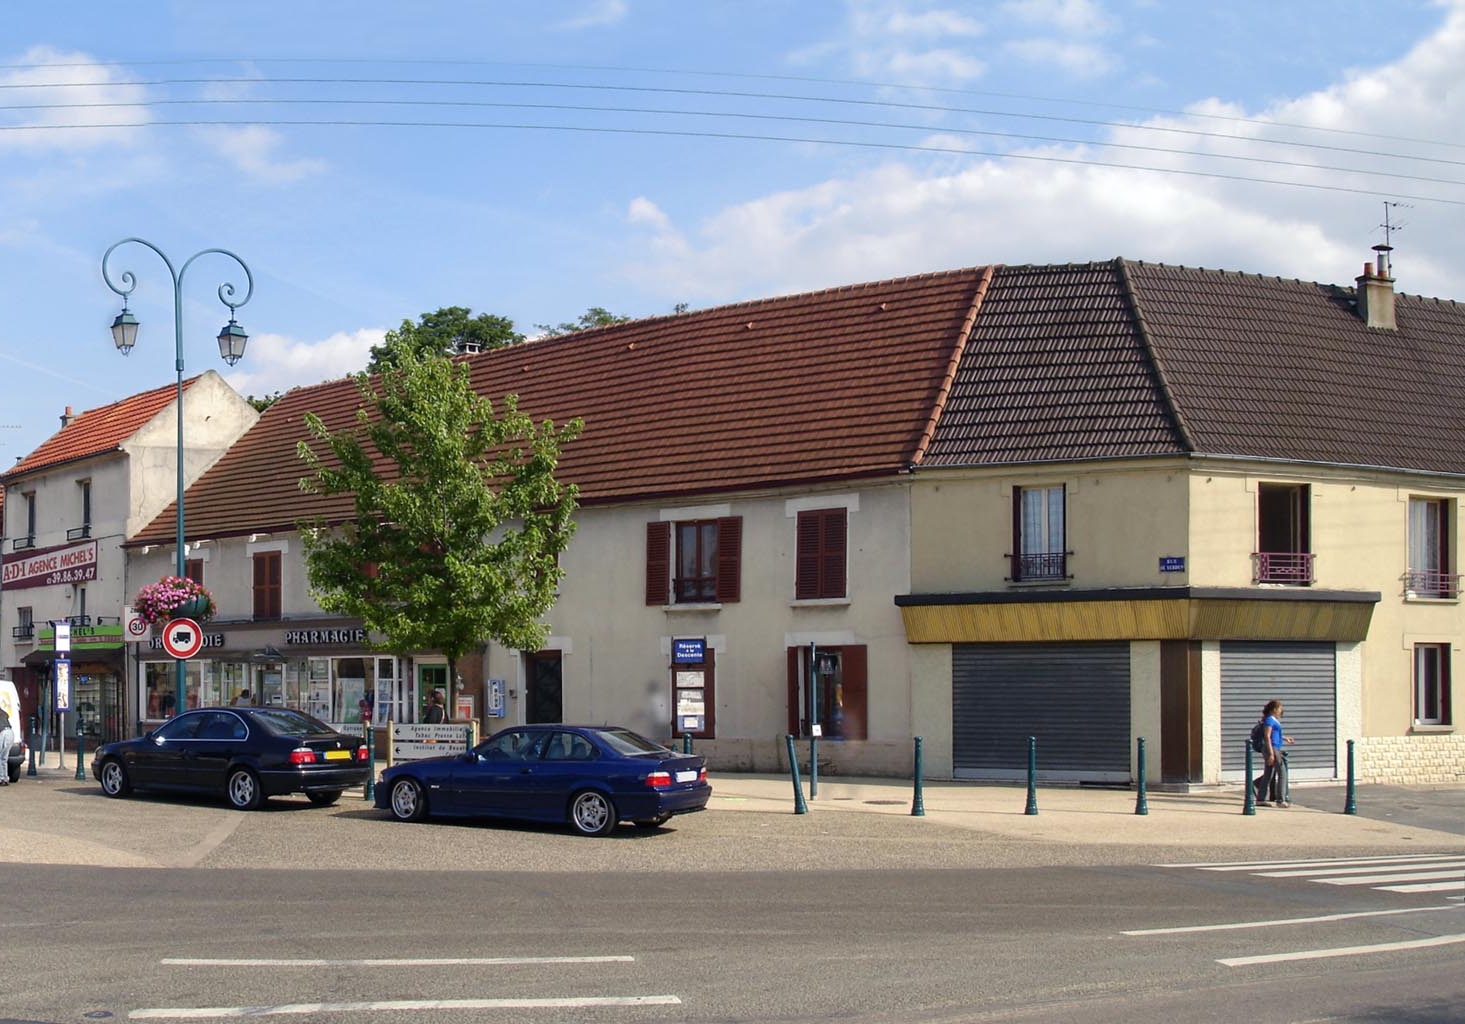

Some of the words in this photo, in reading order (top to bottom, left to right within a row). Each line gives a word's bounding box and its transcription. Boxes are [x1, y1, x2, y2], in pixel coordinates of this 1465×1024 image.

[28, 557, 58, 574] AGENCE
[60, 548, 93, 568] MICHEL'S
[52, 567, 95, 584] 39.86.39.47
[72, 627, 95, 635] HEL'S
[132, 623, 142, 631] 30
[285, 629, 364, 644] PHARMACIE
